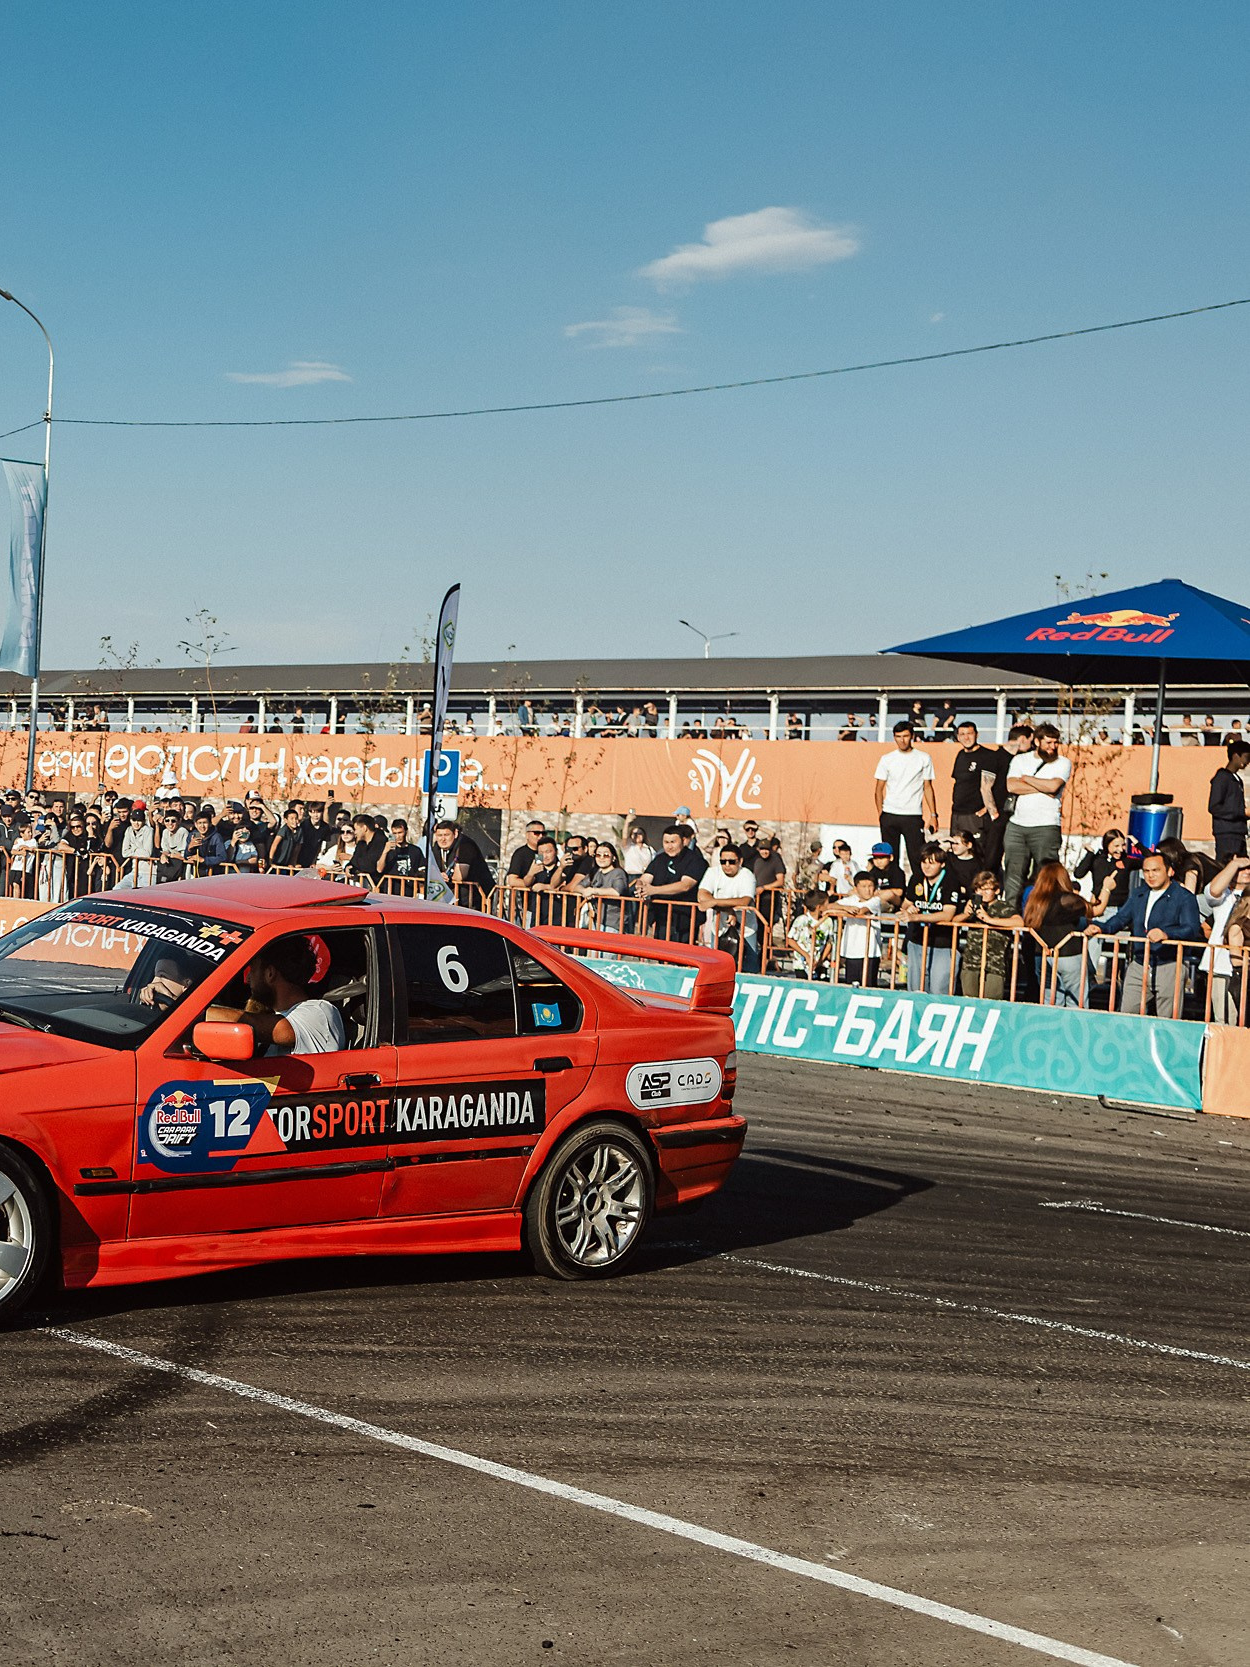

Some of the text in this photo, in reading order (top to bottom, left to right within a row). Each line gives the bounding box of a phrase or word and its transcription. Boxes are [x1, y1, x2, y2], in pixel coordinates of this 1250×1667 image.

[1025, 627, 1175, 643] Red Bull
[116, 918, 226, 962] KARAGANDA
[437, 945, 469, 993] 6
[640, 1072, 671, 1090] ASP
[156, 1108, 202, 1124] Red Bull
[208, 1098, 251, 1138] 12
[396, 1091, 535, 1133] KARAGANDA
[174, 1125, 197, 1133] PARK
[157, 1133, 197, 1144] DRIFT
